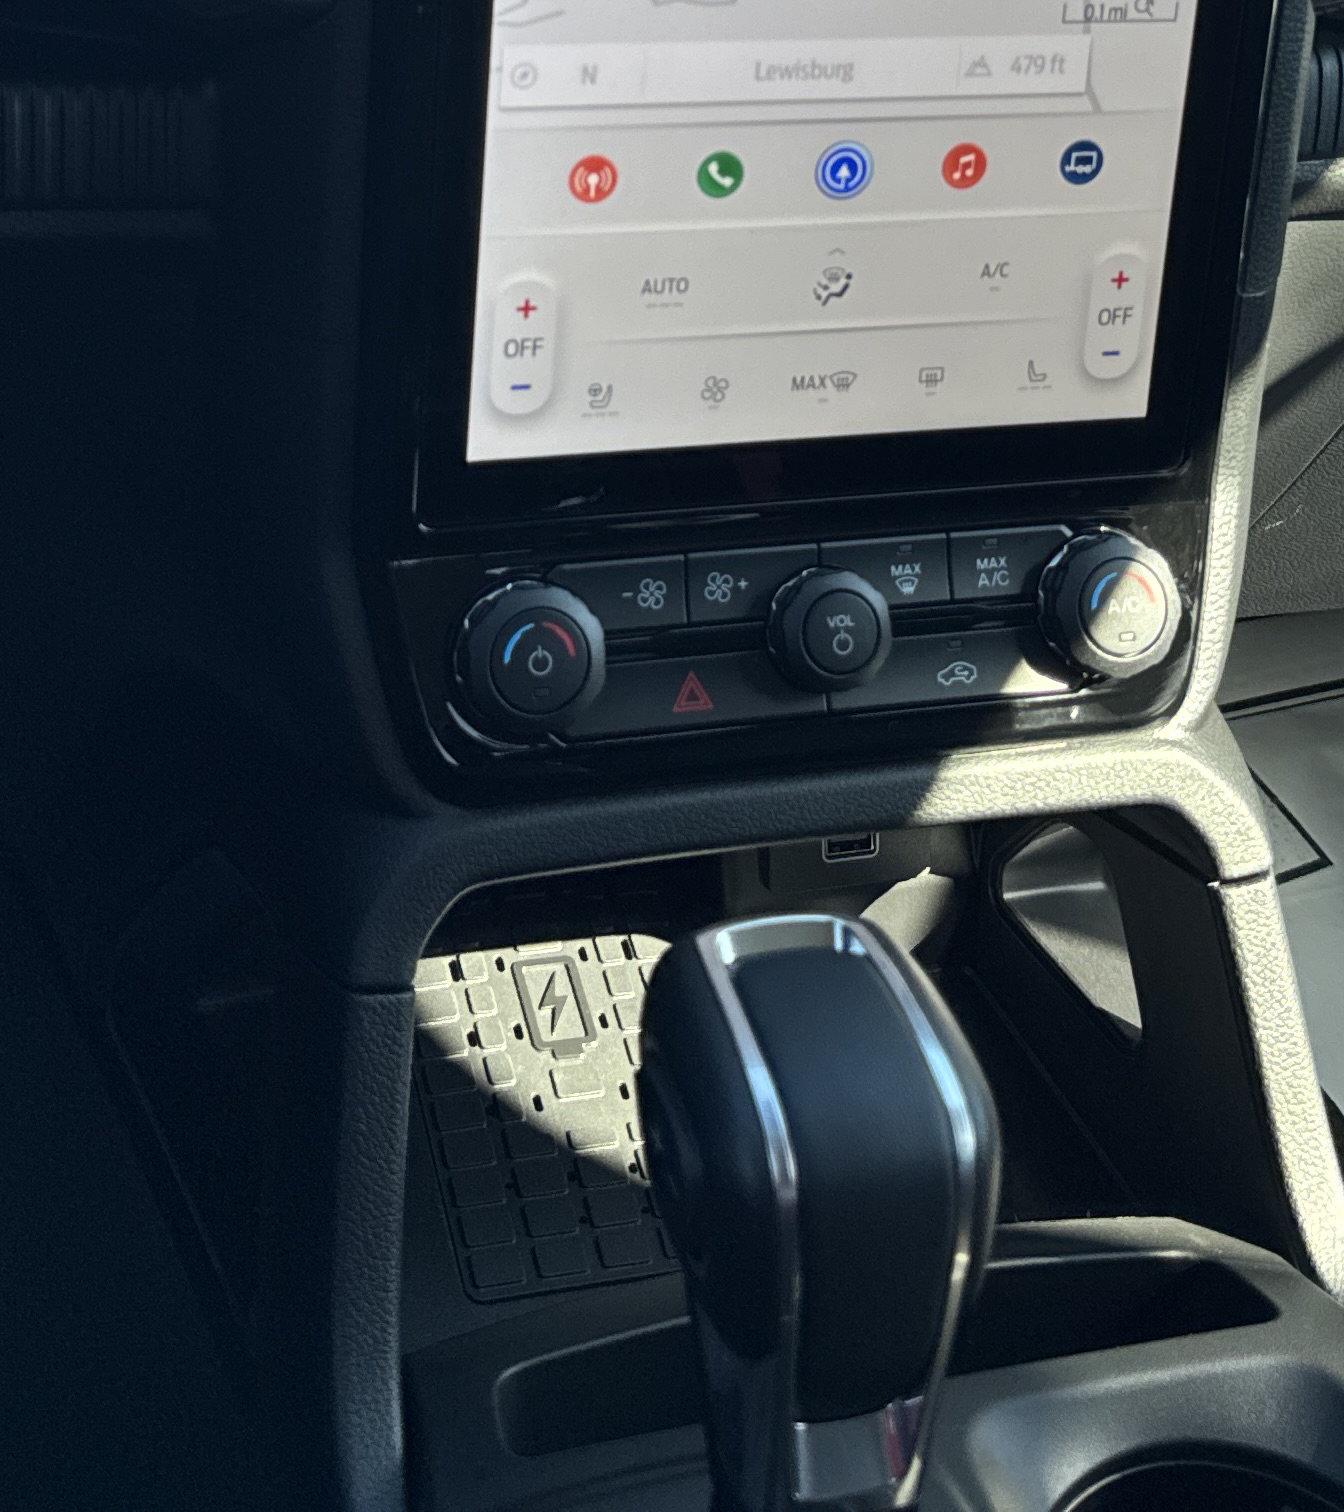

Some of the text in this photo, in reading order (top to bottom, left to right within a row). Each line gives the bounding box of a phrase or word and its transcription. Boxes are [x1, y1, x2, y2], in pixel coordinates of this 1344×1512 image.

[1107, 2, 1129, 22] mi
[580, 52, 1066, 86] N Lewisburg 479 ft
[979, 261, 1010, 281] A/C
[640, 276, 690, 296] AUTO
[1097, 306, 1134, 327] OFF
[503, 337, 545, 359] OFF
[790, 374, 829, 392] MAX
[890, 562, 922, 578] MAX
[976, 556, 1008, 571] MAX
[977, 570, 1010, 588] A/C
[1107, 597, 1141, 616] A/C
[826, 613, 856, 629] VOL
